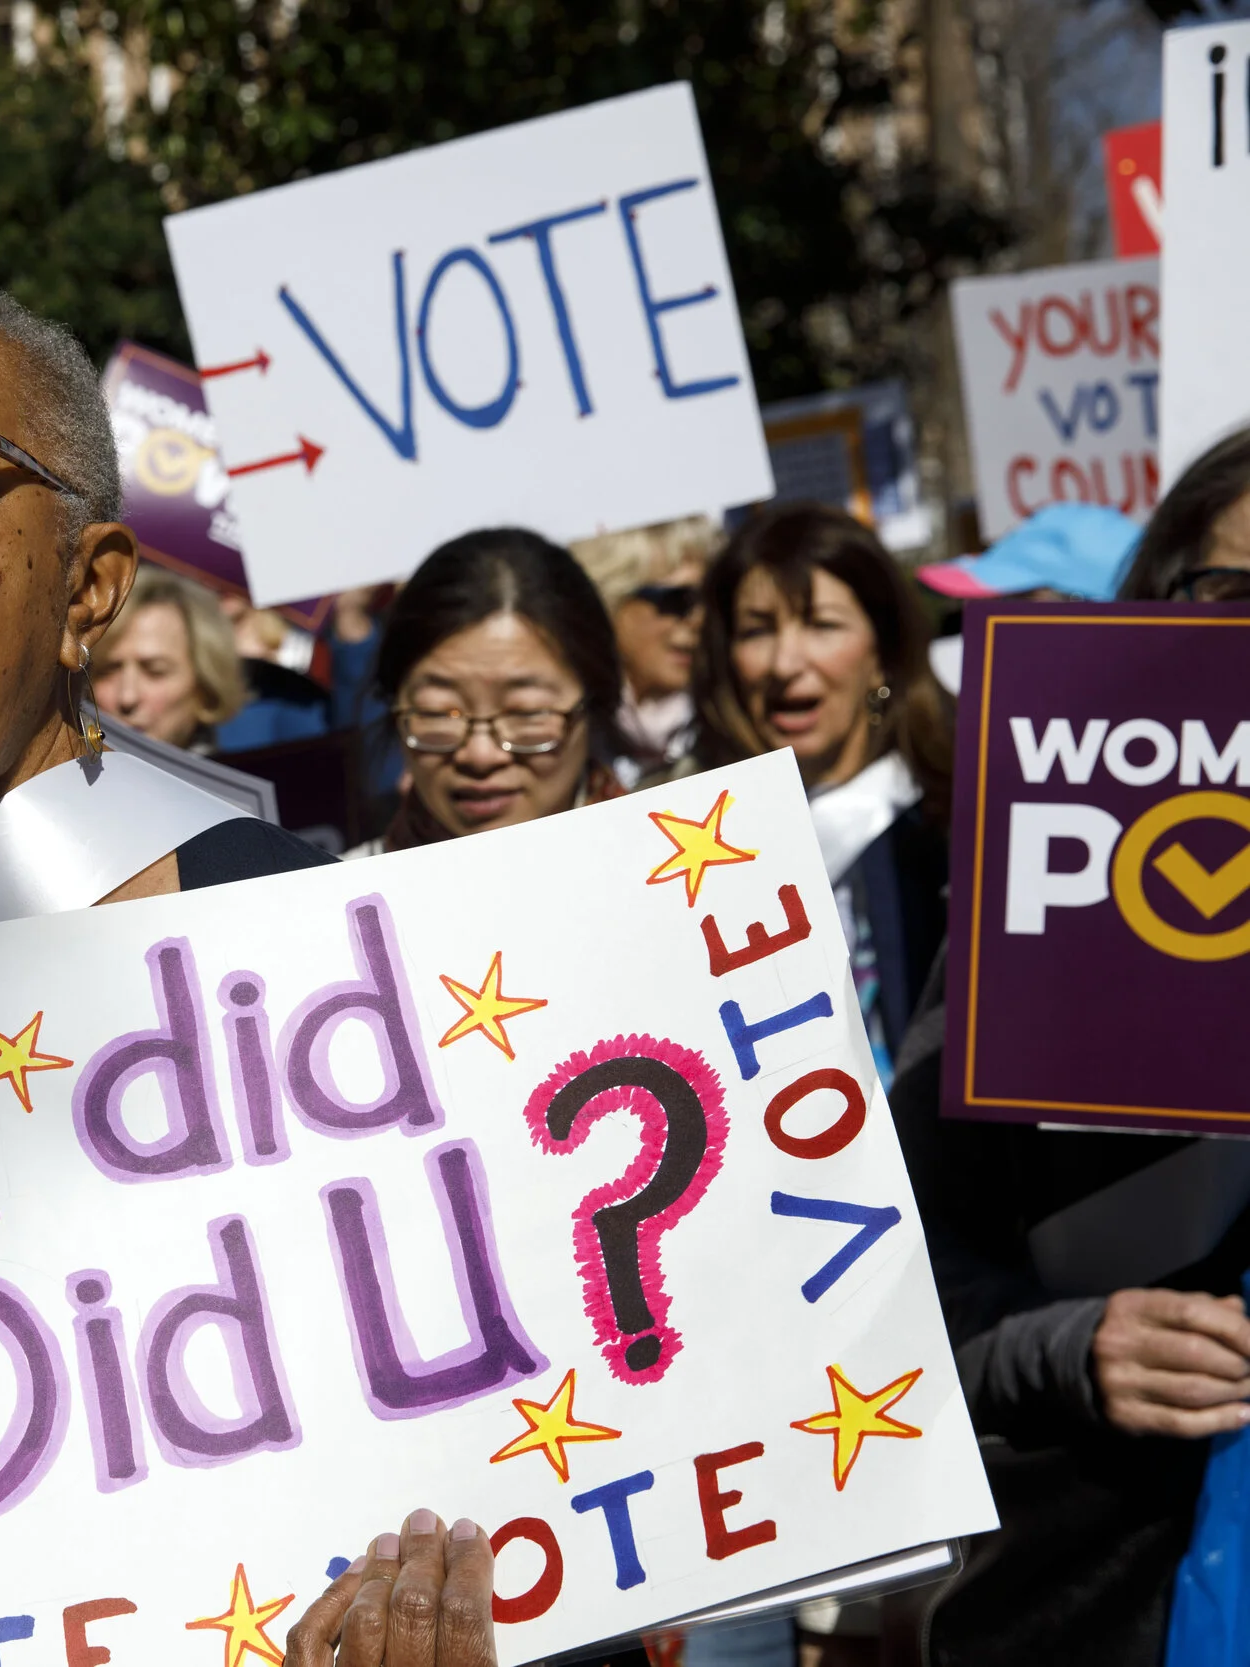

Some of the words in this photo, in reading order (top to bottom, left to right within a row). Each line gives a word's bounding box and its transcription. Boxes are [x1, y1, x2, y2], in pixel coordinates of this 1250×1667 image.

[277, 178, 742, 463] VOTE
[986, 283, 1160, 395] YOUR
[1009, 717, 1250, 786] WOM
[71, 892, 446, 1184] did
[700, 884, 901, 1303] VOTE
[326, 1441, 778, 1625] OTE
